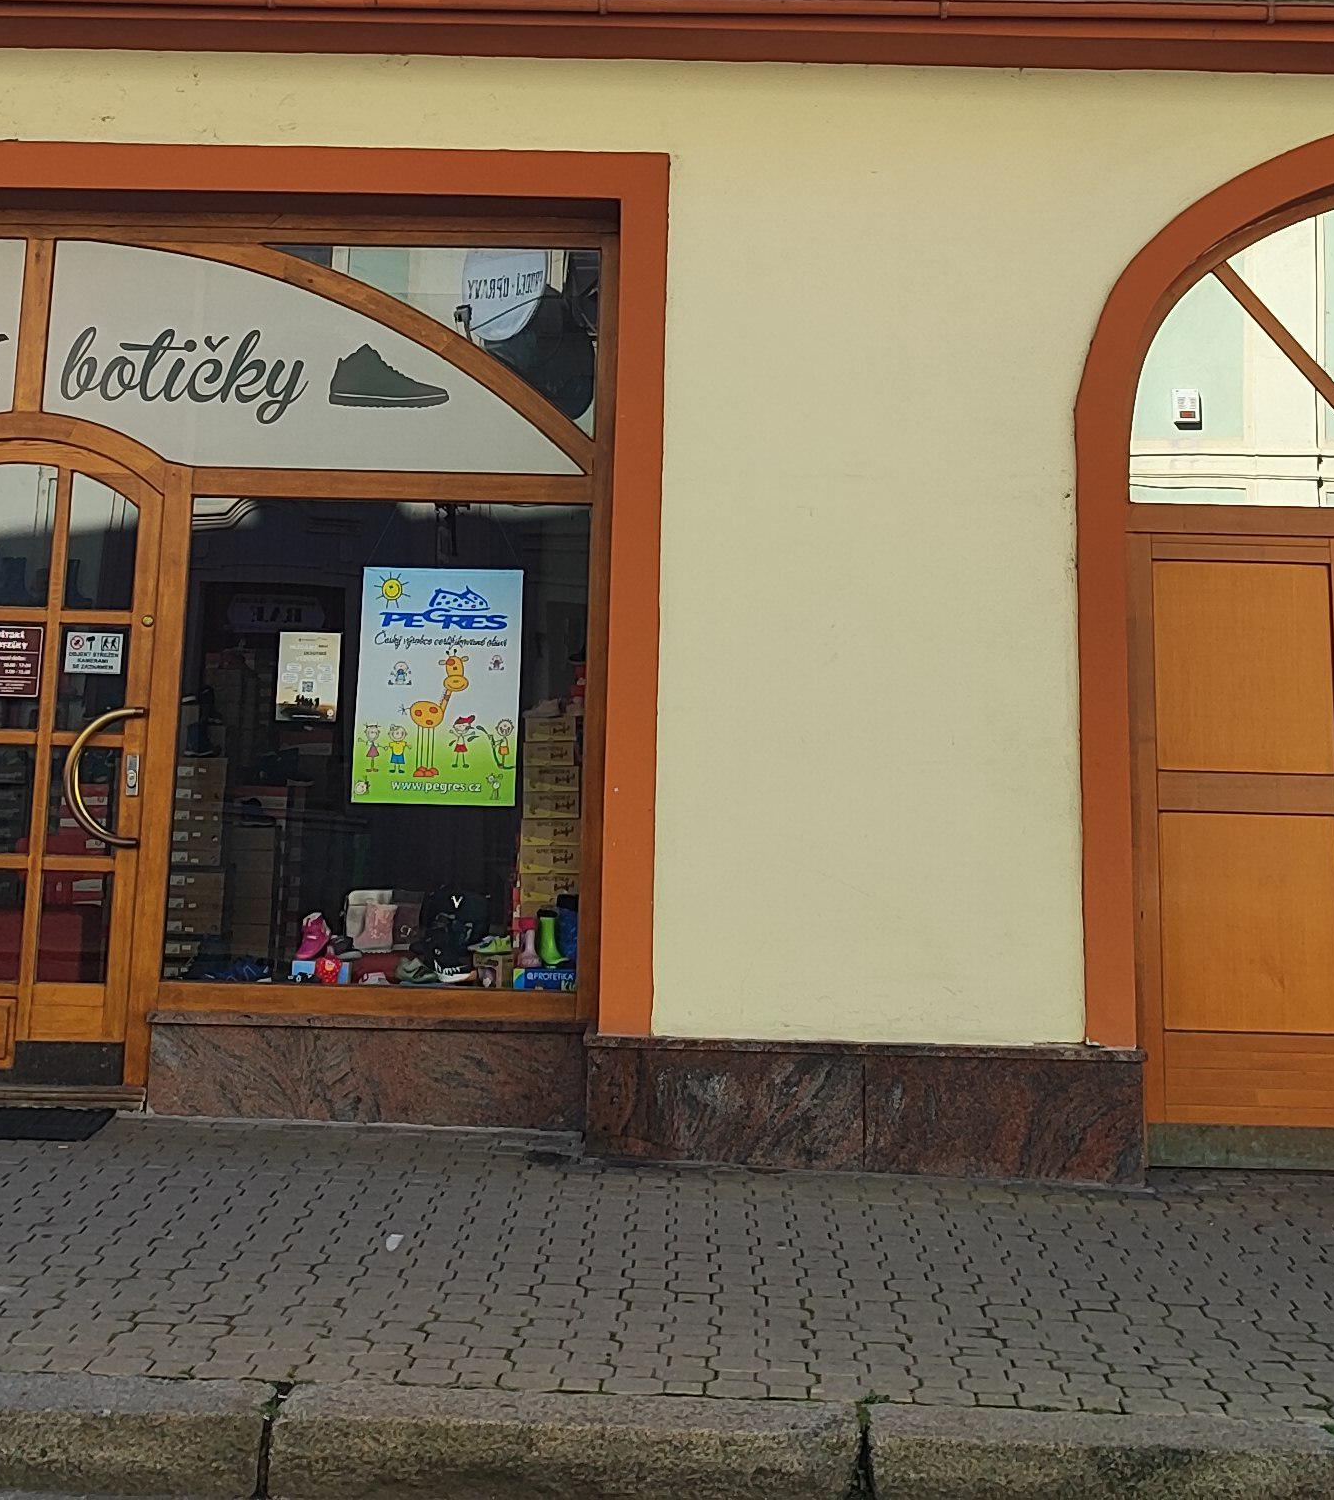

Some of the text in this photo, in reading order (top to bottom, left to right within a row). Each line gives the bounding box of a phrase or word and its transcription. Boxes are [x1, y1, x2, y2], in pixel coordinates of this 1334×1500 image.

[60, 328, 308, 425] botičky
[379, 608, 508, 630] PEGRES
[374, 630, 403, 649] Český
[391, 780, 481, 794] www.pegres.cz
[534, 972, 574, 981] PROTETIKA
